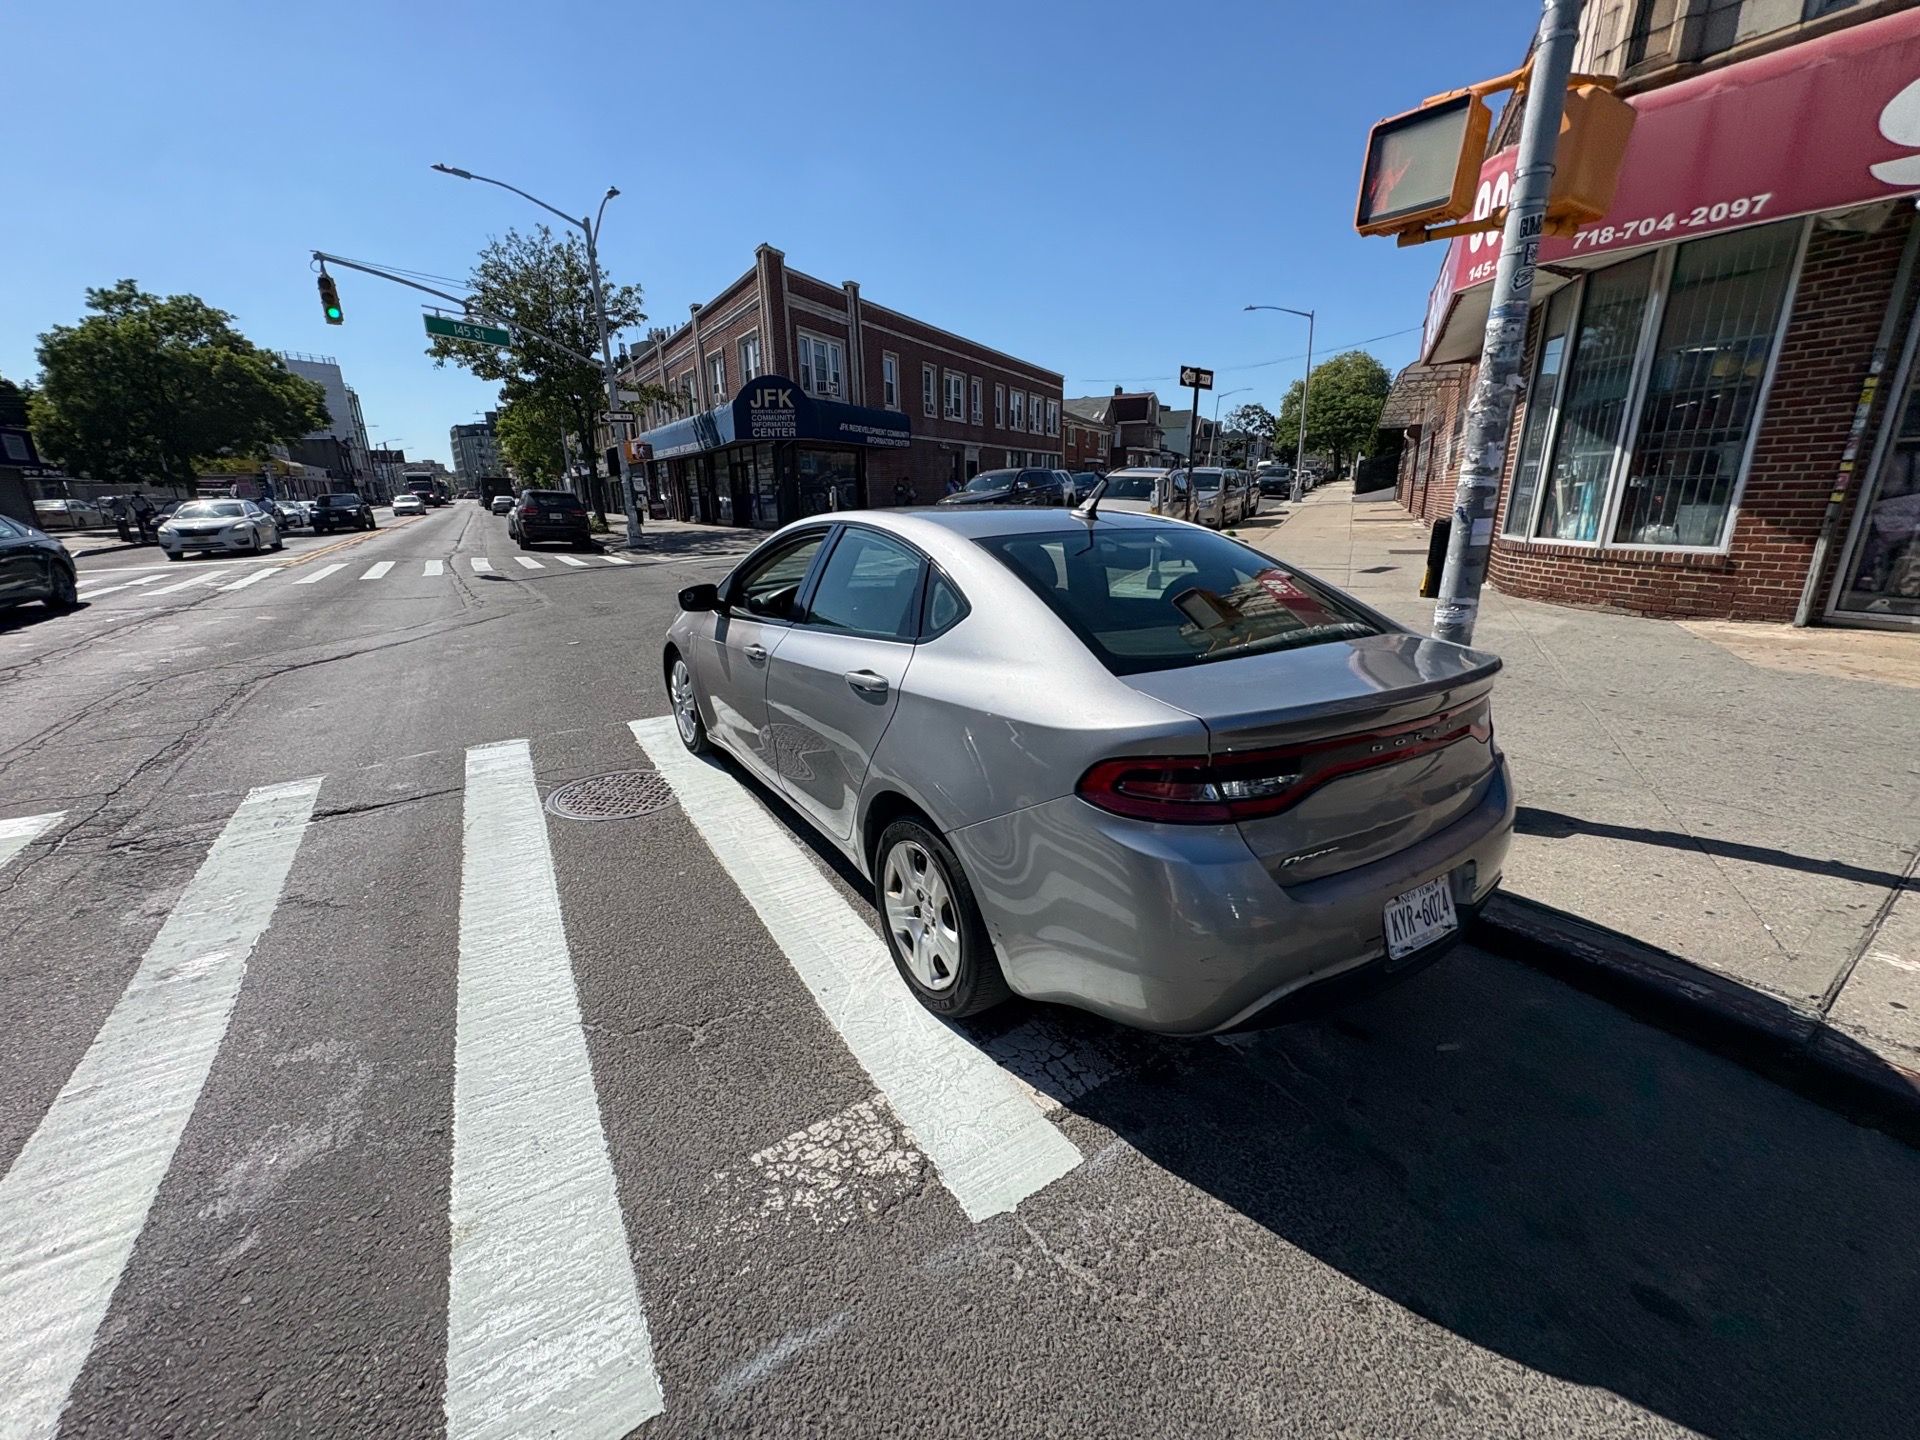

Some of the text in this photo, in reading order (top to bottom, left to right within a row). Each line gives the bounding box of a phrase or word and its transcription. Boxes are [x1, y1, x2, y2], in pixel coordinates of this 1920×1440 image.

[453, 324, 486, 340] 145 St
[750, 388, 794, 408] JFK
[752, 427, 796, 437] CENTER
